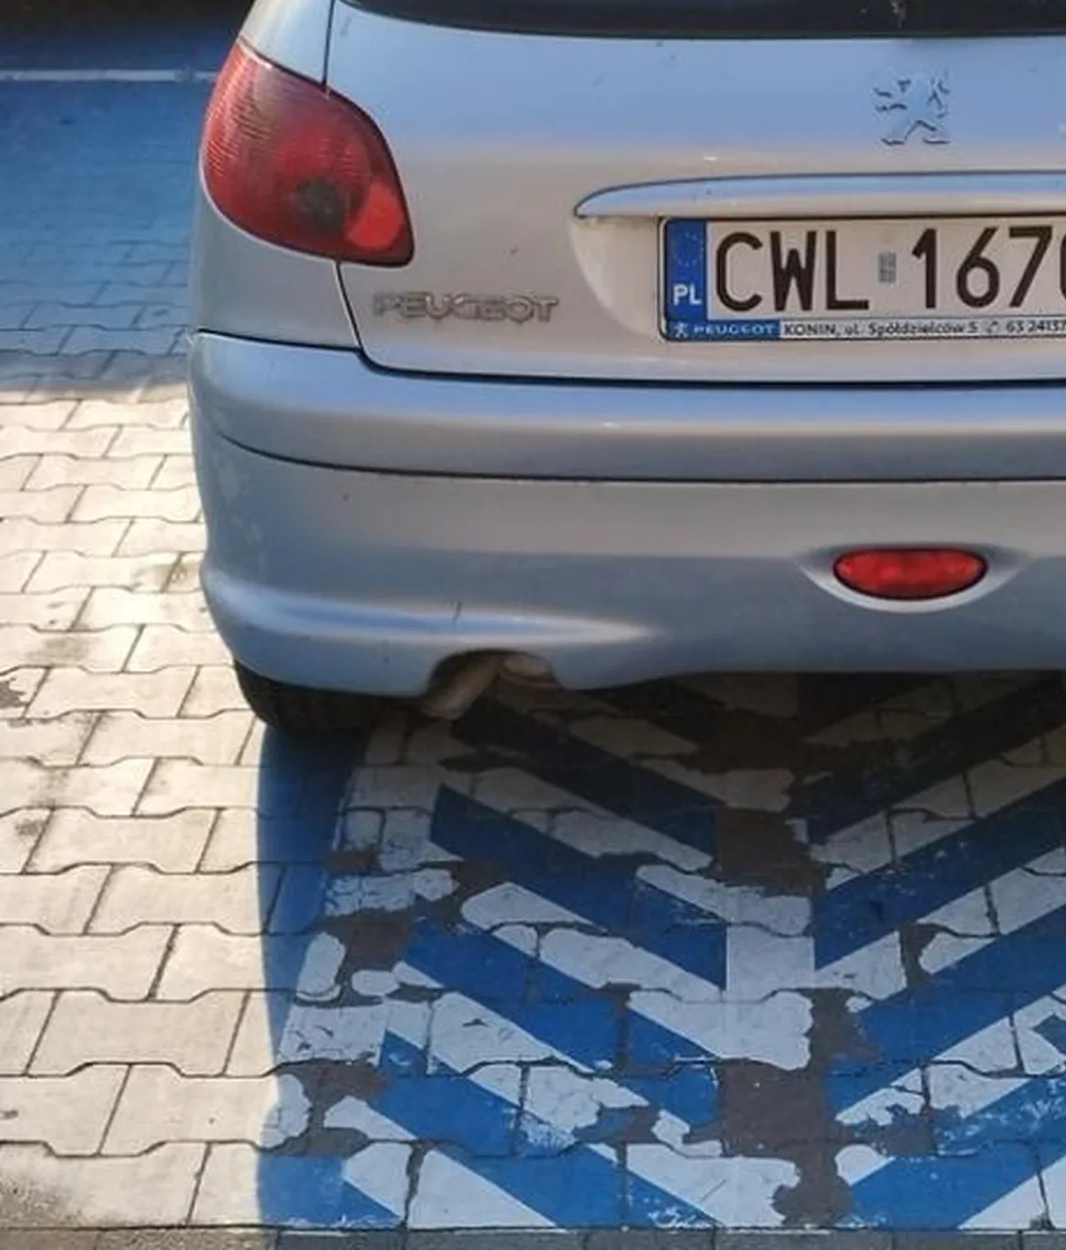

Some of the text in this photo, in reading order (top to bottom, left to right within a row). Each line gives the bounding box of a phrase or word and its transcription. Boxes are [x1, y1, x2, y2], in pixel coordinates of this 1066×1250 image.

[715, 229, 869, 312] CWL
[372, 291, 560, 324] PEUGEOT
[672, 281, 703, 307] PL
[693, 322, 775, 335] PEUGEOT
